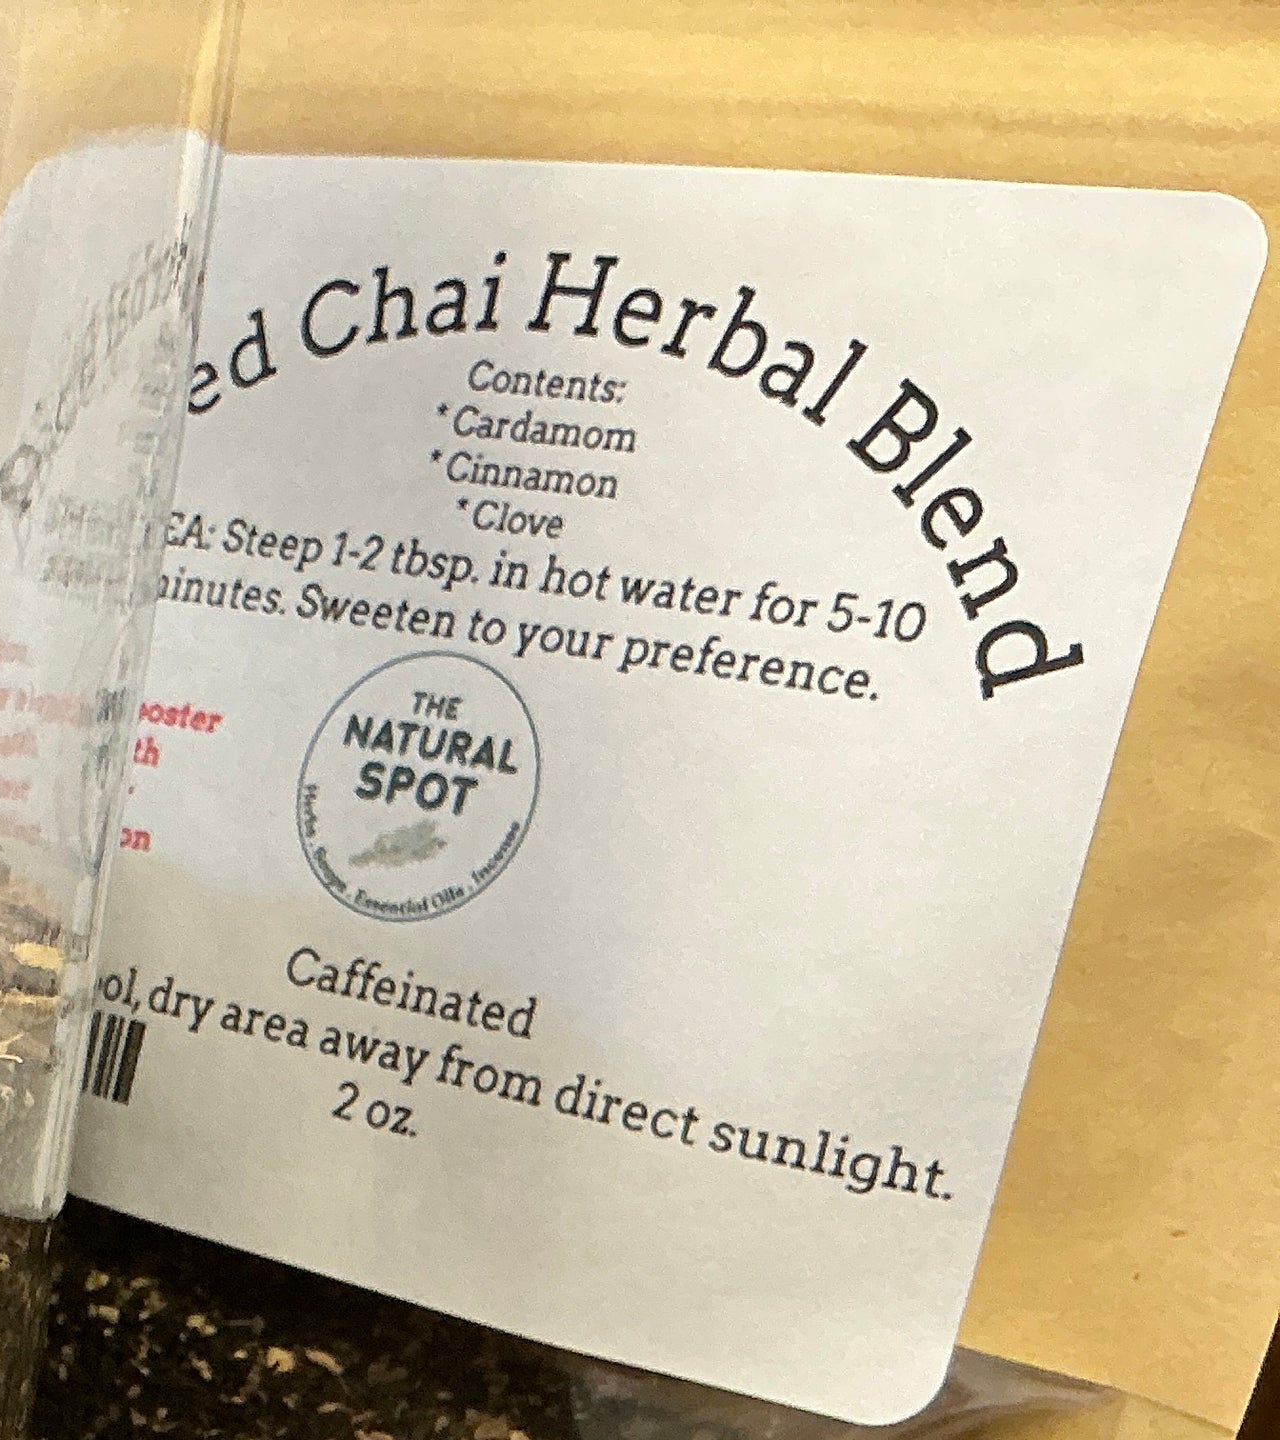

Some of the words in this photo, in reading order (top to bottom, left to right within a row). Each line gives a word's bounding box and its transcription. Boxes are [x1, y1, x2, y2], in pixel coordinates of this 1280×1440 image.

[468, 358, 627, 405] Contents:
[301, 250, 508, 357] Chai
[526, 252, 868, 426] Herbal
[846, 378, 1085, 700] Blend
[222, 517, 323, 573] Steep
[332, 531, 385, 572] 1-2
[391, 537, 479, 592] tbsp.
[491, 549, 528, 590] in
[539, 553, 611, 602] hot
[620, 575, 743, 617] water
[748, 580, 819, 628] for
[827, 591, 927, 643] 5-10
[296, 581, 456, 640] Sweeten
[466, 607, 507, 647] to
[513, 621, 615, 659] your
[617, 632, 880, 702] preference.
[342, 713, 519, 775] NATURAL
[413, 690, 464, 721] THE
[354, 761, 479, 817] SPOT
[285, 946, 538, 1040] Caffeinated
[148, 974, 215, 1034] dry
[219, 1002, 309, 1049] area
[319, 1025, 430, 1086] away
[436, 1043, 541, 1107] from
[554, 1073, 700, 1147] direct
[708, 1120, 952, 1201] sunlight.
[331, 1080, 359, 1122] 2
[365, 1100, 418, 1138] oz.
